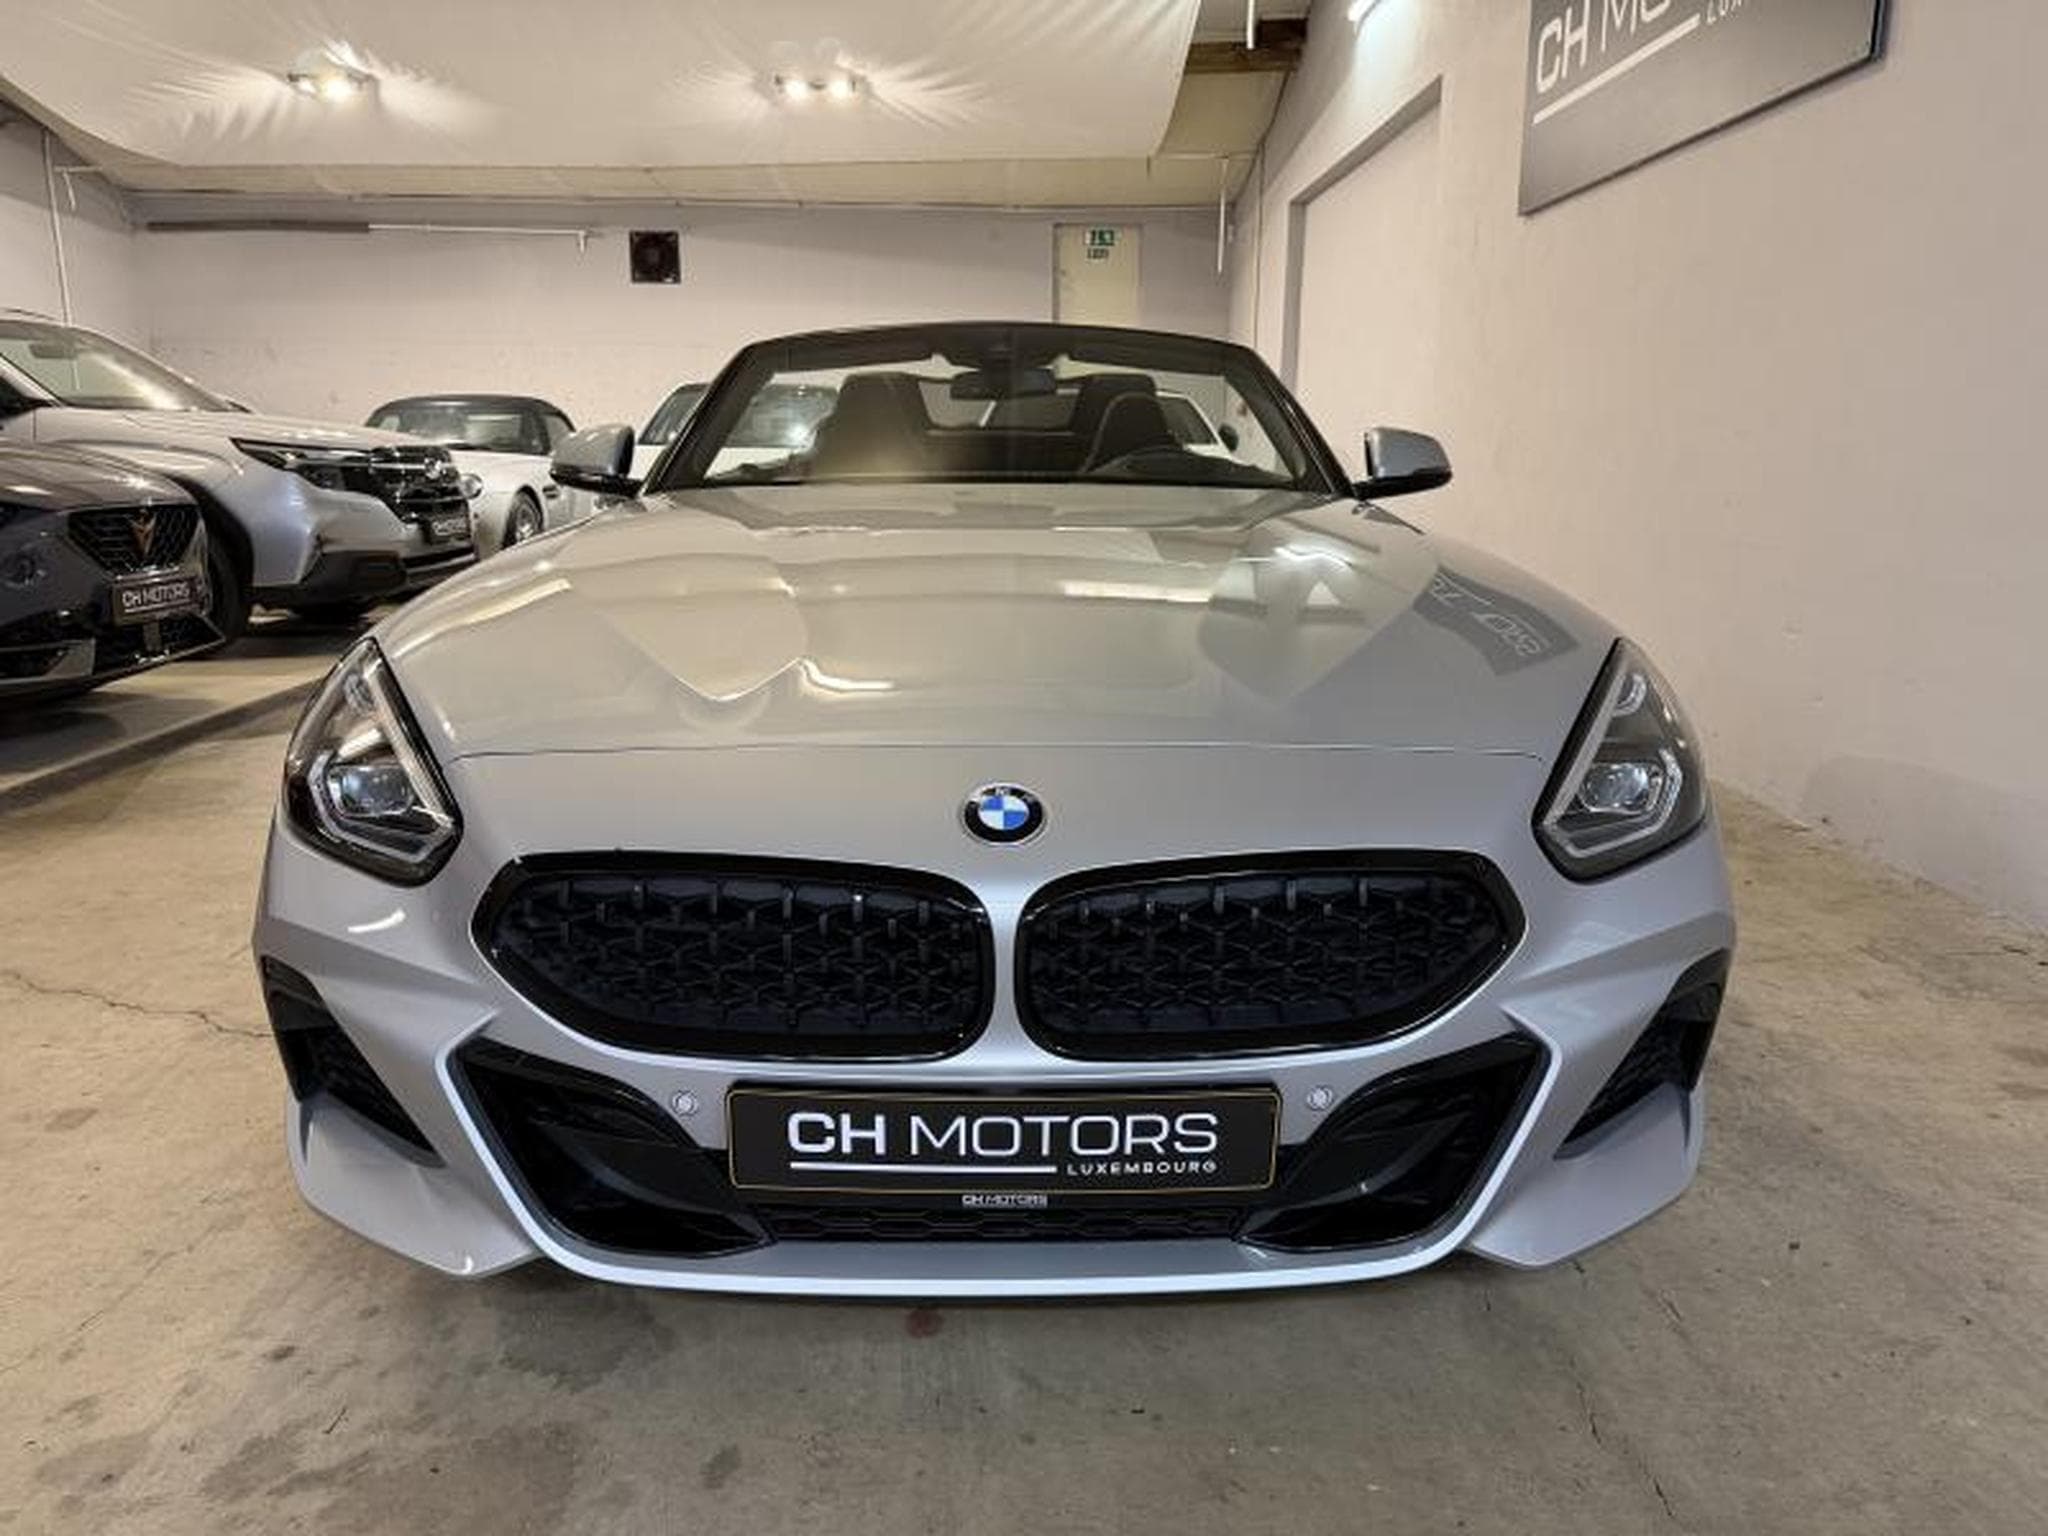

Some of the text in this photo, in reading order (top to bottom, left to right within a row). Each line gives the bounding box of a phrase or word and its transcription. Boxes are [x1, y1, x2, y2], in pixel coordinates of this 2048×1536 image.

[1536, 0, 1591, 94] CH
[787, 1111, 1218, 1157] CH MOTORS
[1066, 1160, 1217, 1176] LUXEMBOURG
[961, 1194, 985, 1206] CH
